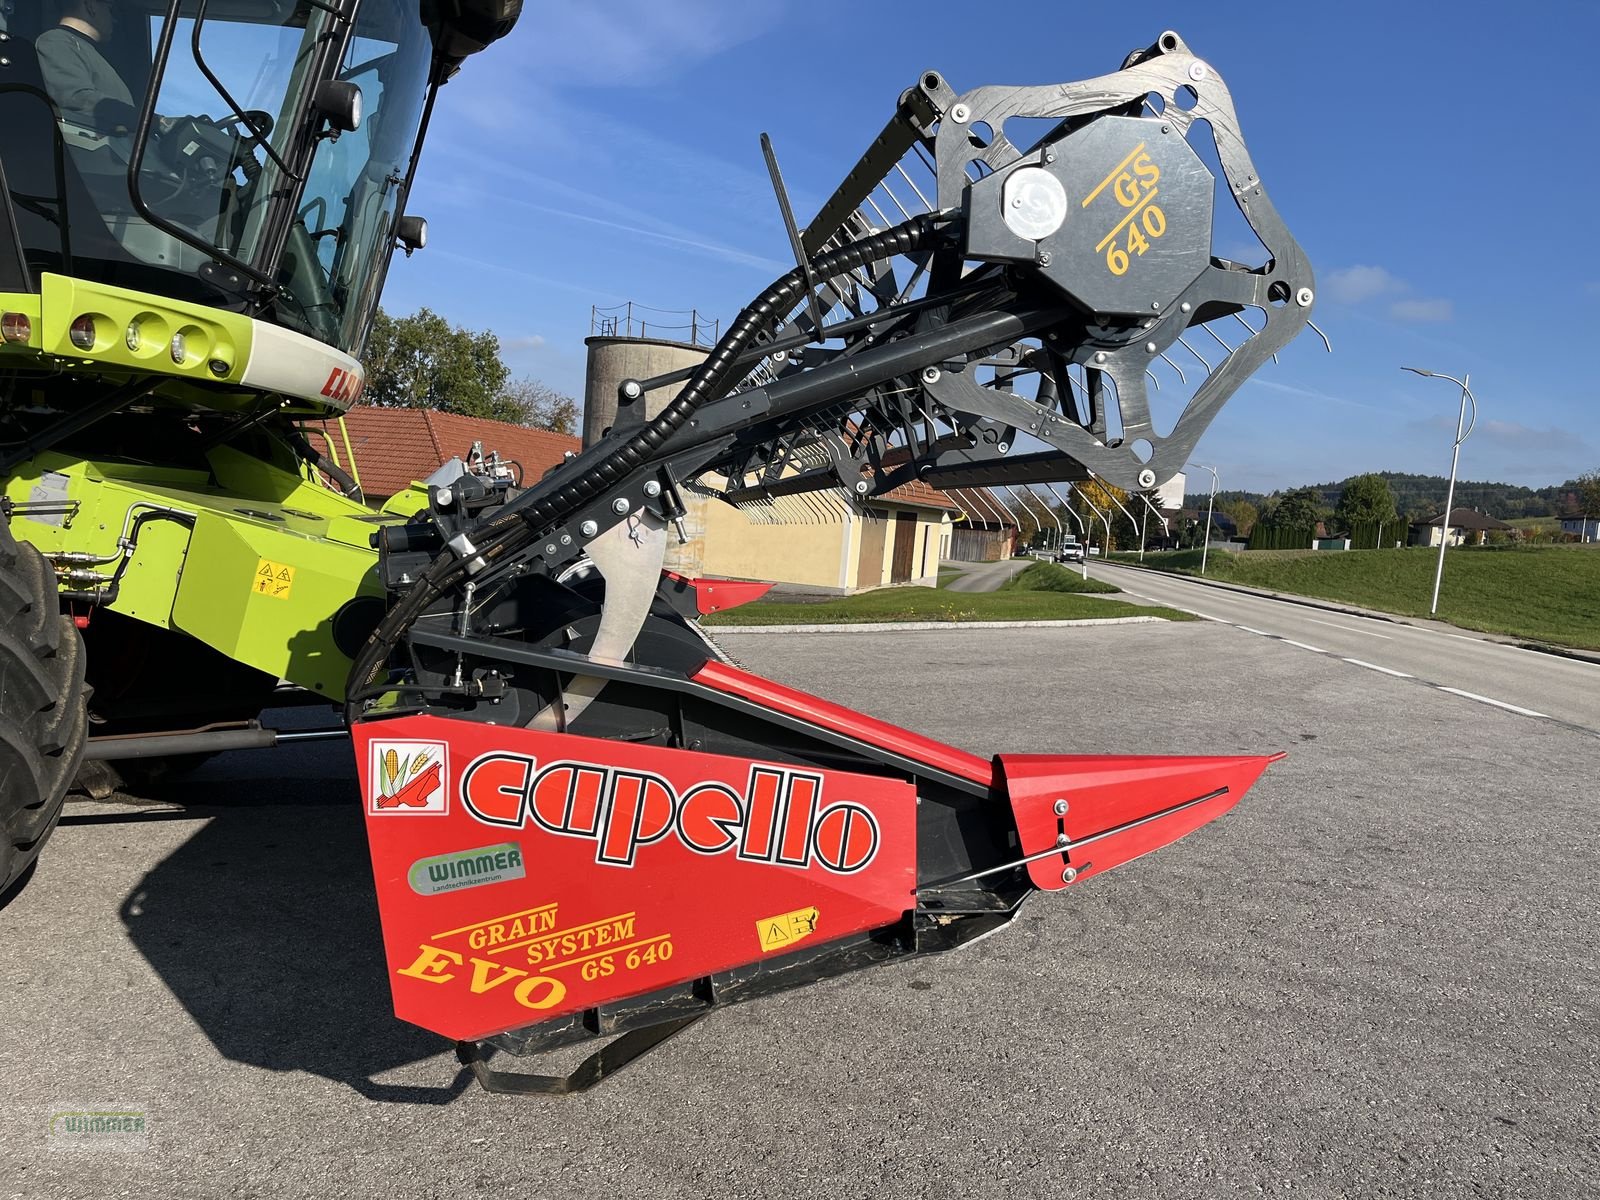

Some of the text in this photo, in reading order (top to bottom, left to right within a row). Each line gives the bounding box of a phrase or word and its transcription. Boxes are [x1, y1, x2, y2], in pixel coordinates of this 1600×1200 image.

[1114, 153, 1160, 208] GS
[1106, 205, 1167, 276] 640
[320, 367, 361, 405] CLA
[428, 850, 521, 883] WIMMER
[432, 874, 502, 892] Landtechnikzentrum
[468, 908, 558, 949] GRAIN
[526, 917, 636, 965] SYSTEM
[396, 944, 567, 1009] EVO
[581, 940, 673, 981] GS 640
